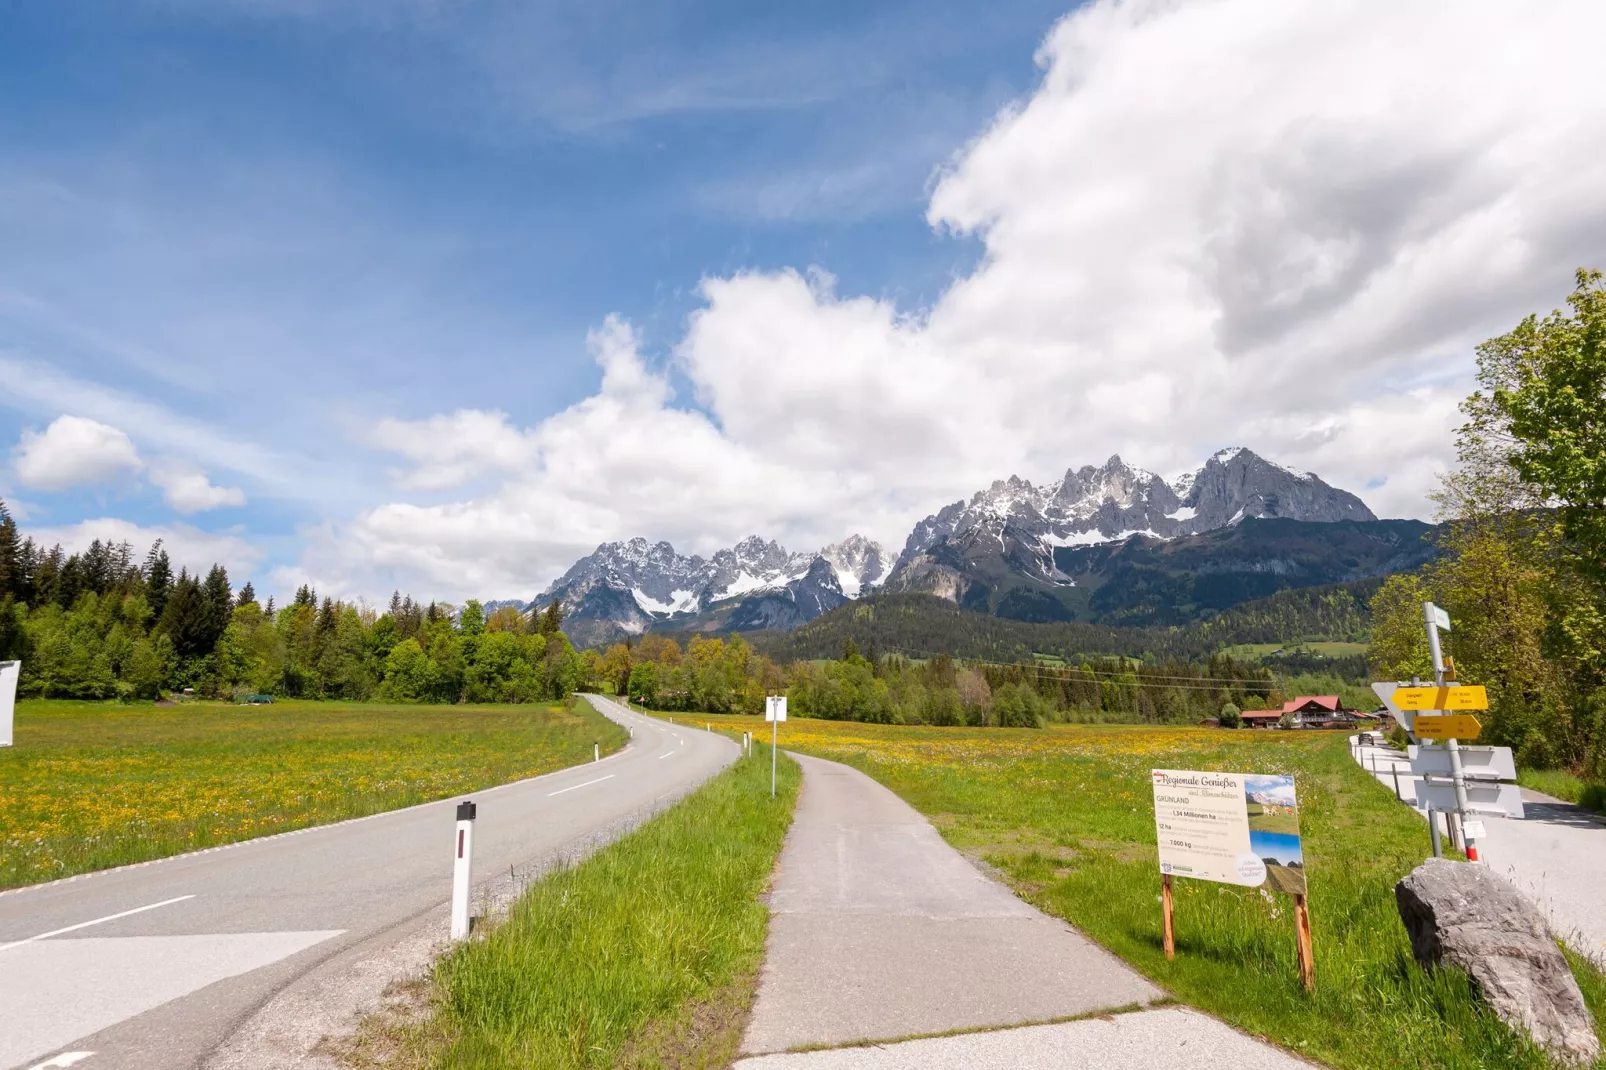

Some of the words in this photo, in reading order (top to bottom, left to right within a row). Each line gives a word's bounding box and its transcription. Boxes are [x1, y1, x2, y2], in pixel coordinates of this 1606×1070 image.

[1162, 774, 1199, 788] Regionale
[1201, 776, 1237, 789] Genießer
[1157, 795, 1189, 804] GRÜNLAND
